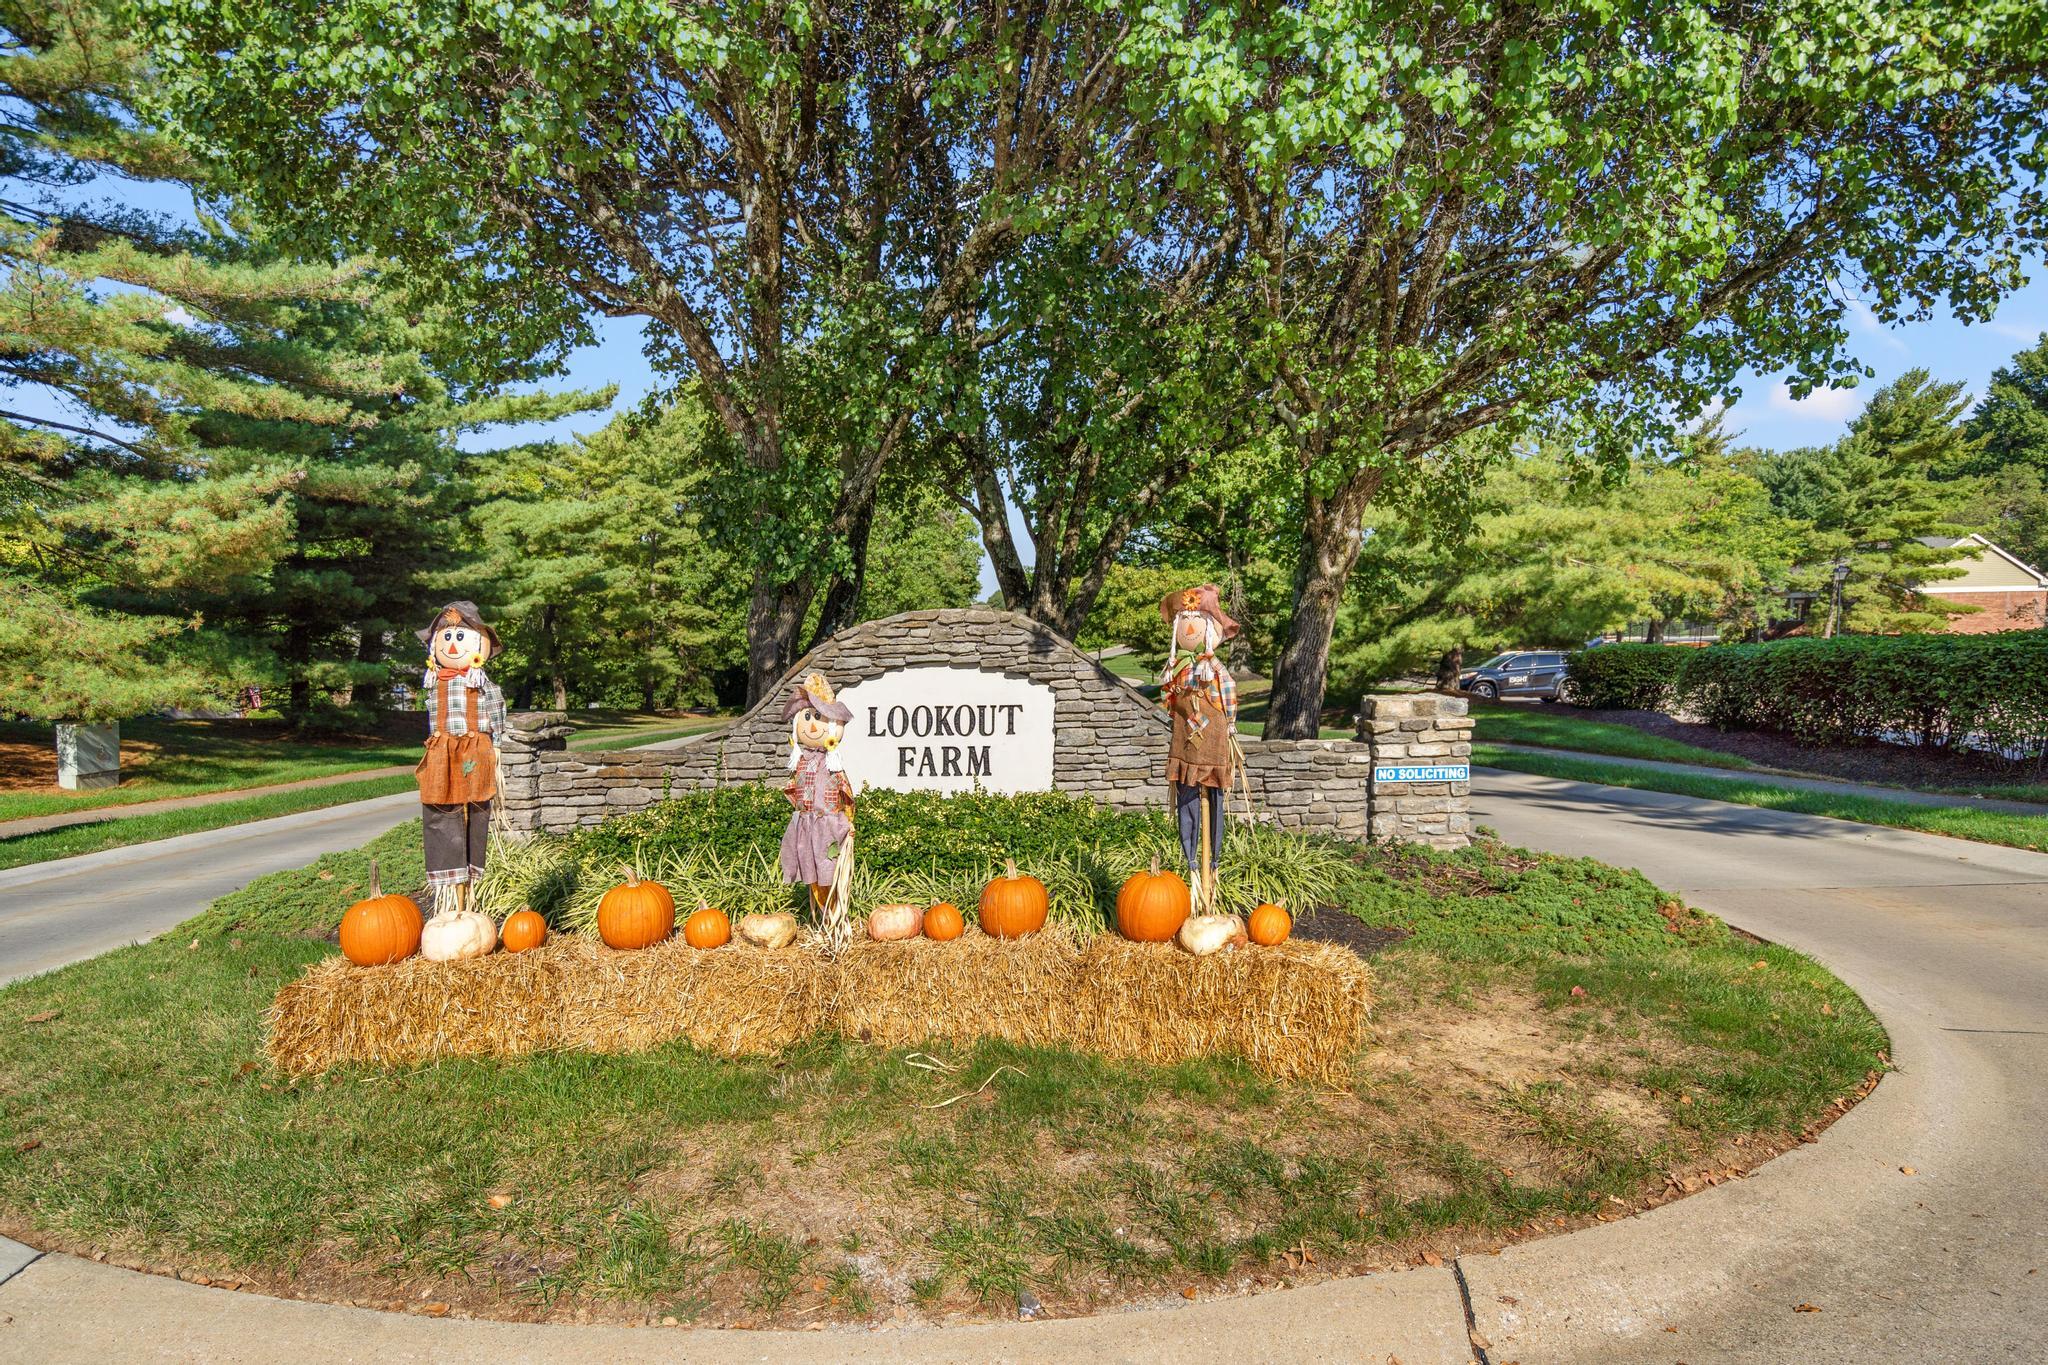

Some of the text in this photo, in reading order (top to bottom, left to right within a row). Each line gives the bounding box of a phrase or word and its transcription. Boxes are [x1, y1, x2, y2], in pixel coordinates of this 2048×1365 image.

[867, 704, 1024, 738] LOOKOUT
[897, 745, 993, 777] FARM
[1378, 767, 1466, 780] NO SOLICITING
